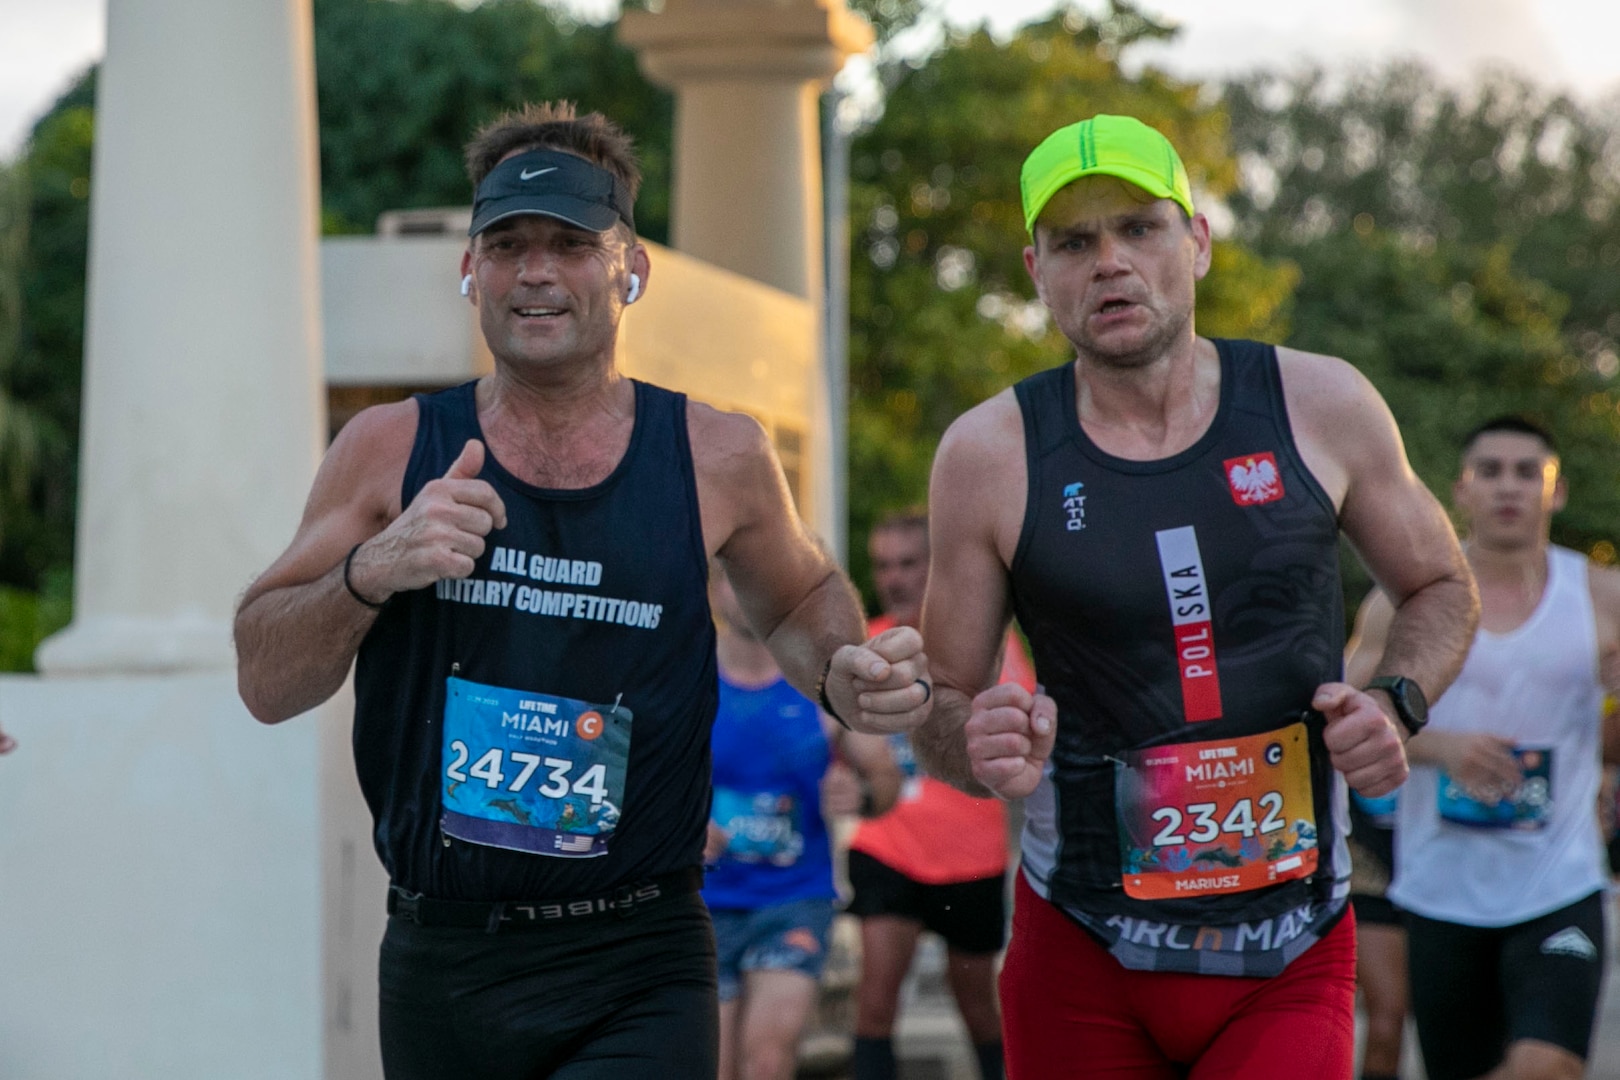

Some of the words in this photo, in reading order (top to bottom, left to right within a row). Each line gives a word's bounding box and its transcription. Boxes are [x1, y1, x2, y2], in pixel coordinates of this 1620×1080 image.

[490, 547, 527, 576] ALL
[529, 554, 603, 586] GUARD
[515, 585, 663, 629] COMPETITIONS
[1170, 565, 1213, 679] POLSKA
[501, 711, 569, 737] MIAMI
[582, 717, 597, 734] C
[1185, 758, 1254, 782] MIAMI
[1267, 746, 1282, 764] C
[446, 740, 609, 804] 24734
[1151, 791, 1286, 847] 2342
[1175, 875, 1240, 890] MARIUSZ
